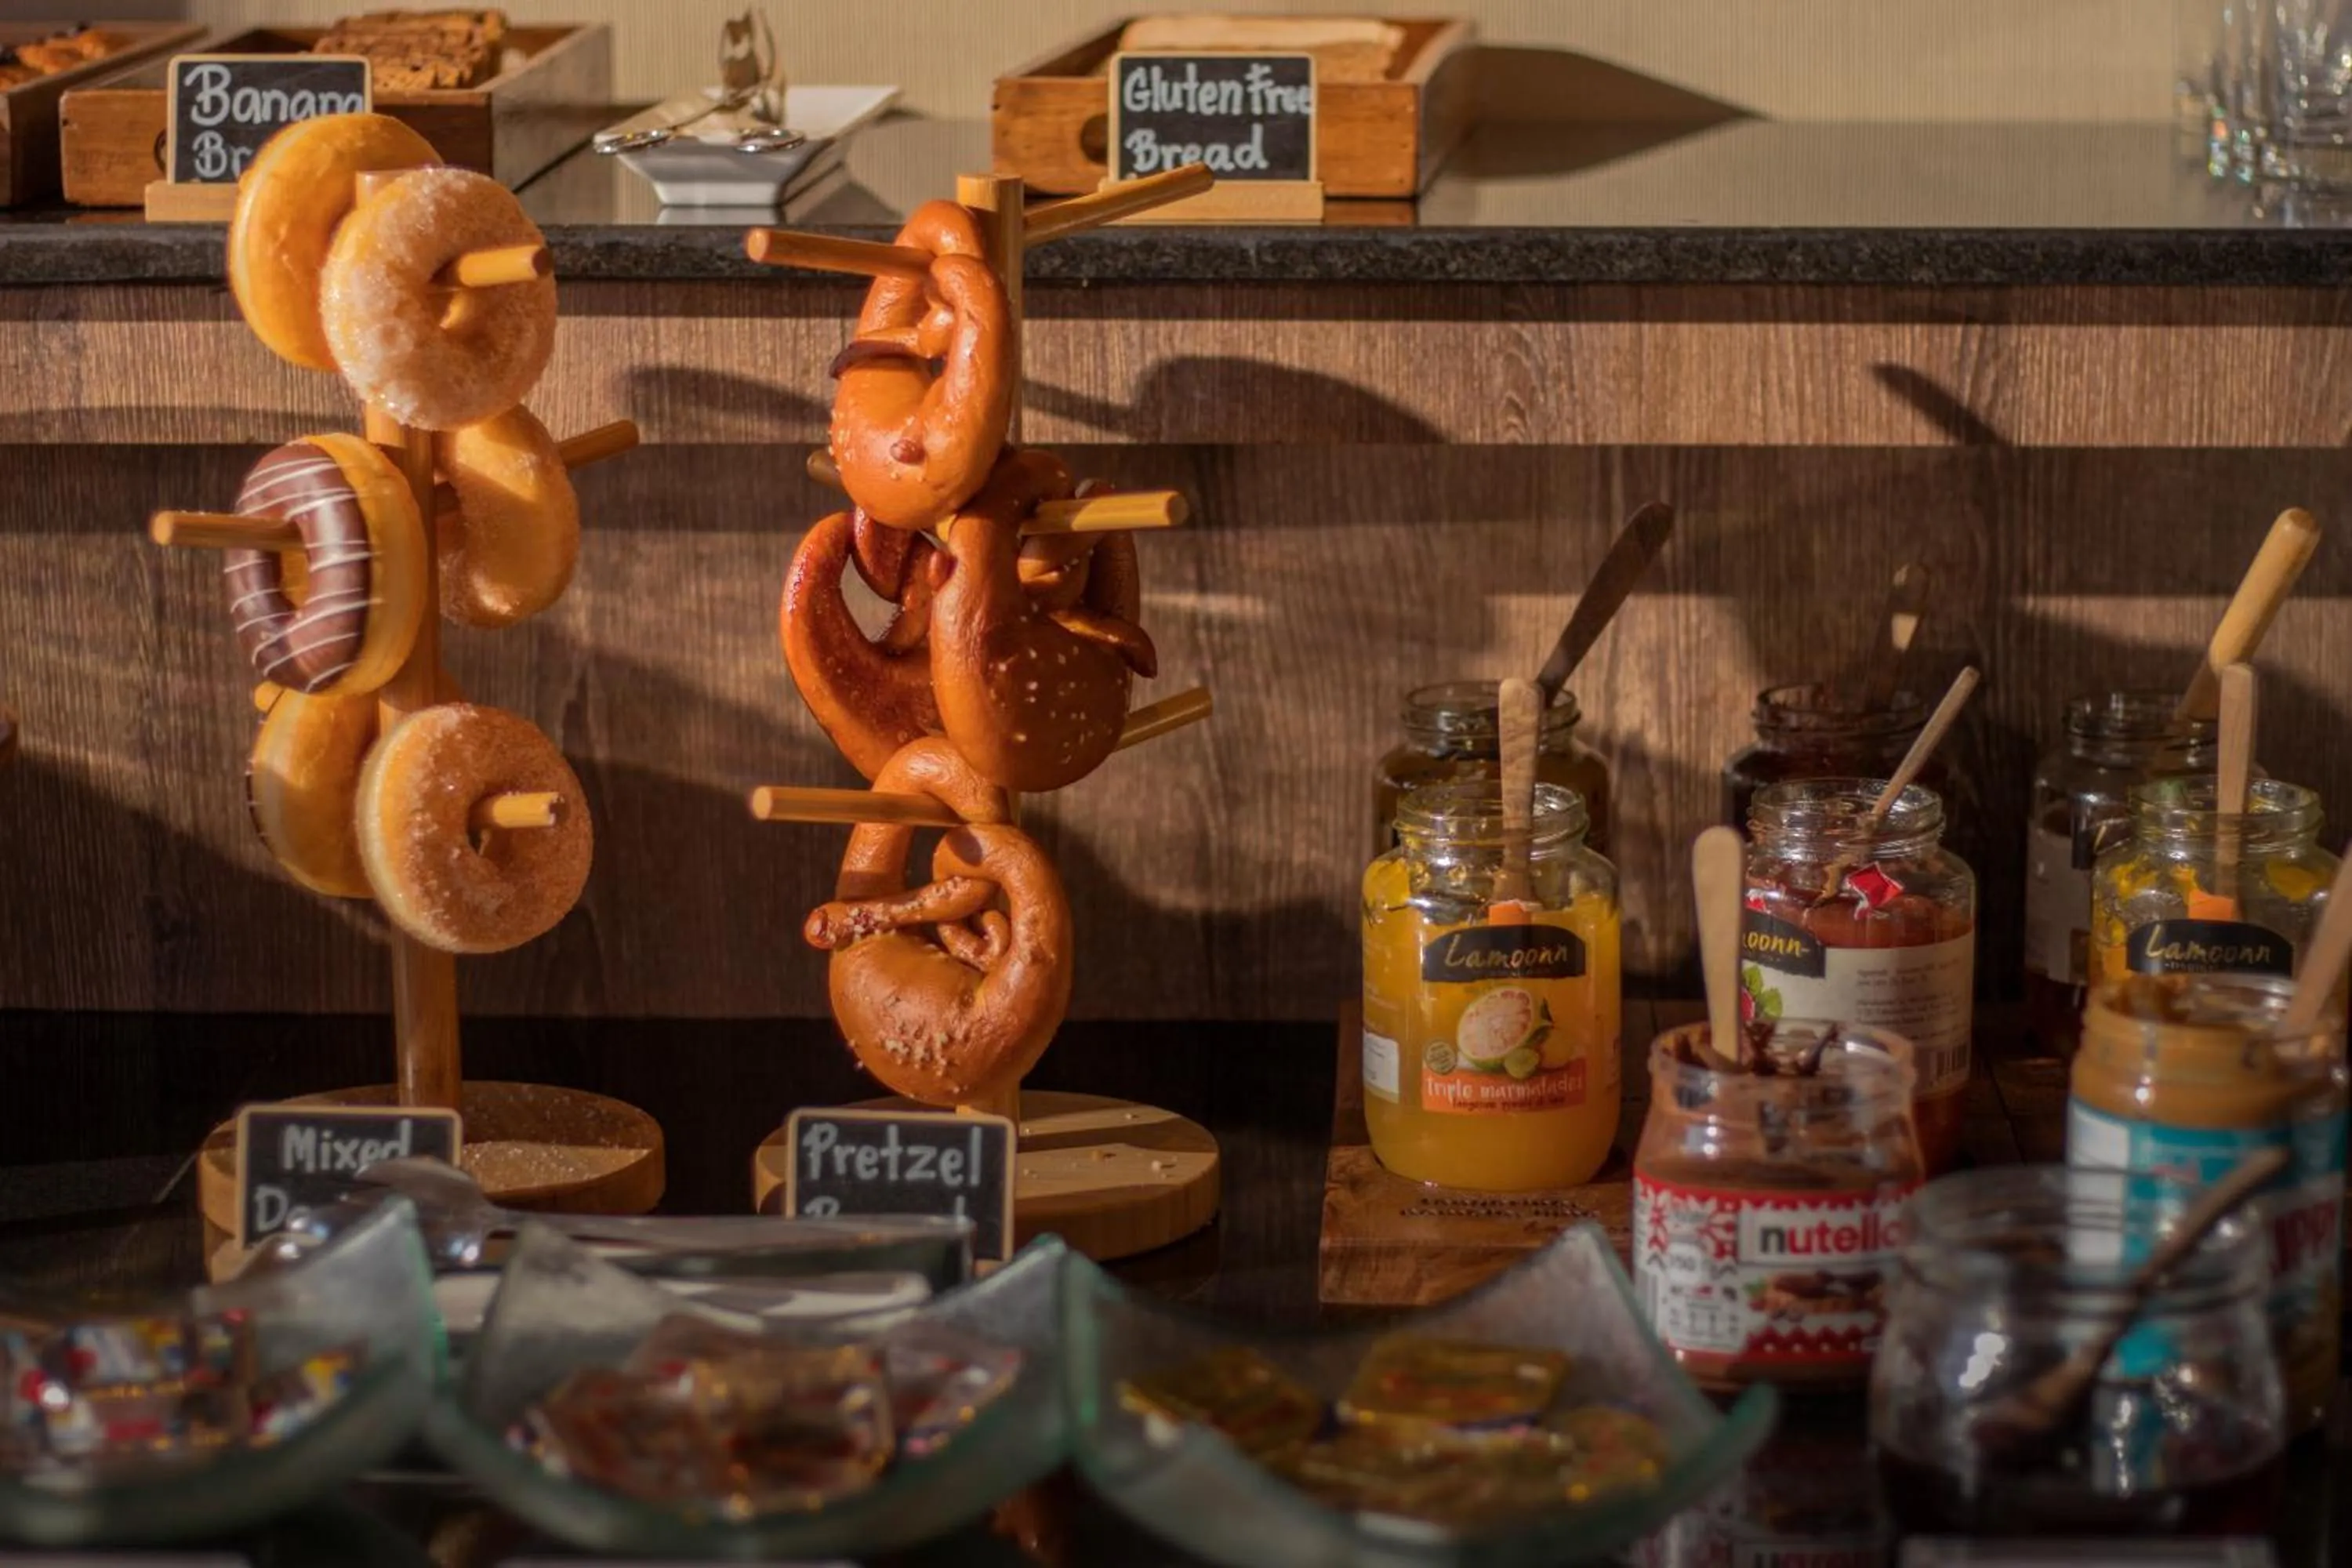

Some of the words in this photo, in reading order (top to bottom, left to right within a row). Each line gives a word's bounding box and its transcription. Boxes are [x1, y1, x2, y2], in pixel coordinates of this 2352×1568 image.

[184, 64, 364, 126] Banana
[1123, 63, 1244, 115] Gluten
[1124, 122, 1269, 172] Bread
[282, 1119, 412, 1173] Mixed
[803, 1122, 982, 1186] Pretzel
